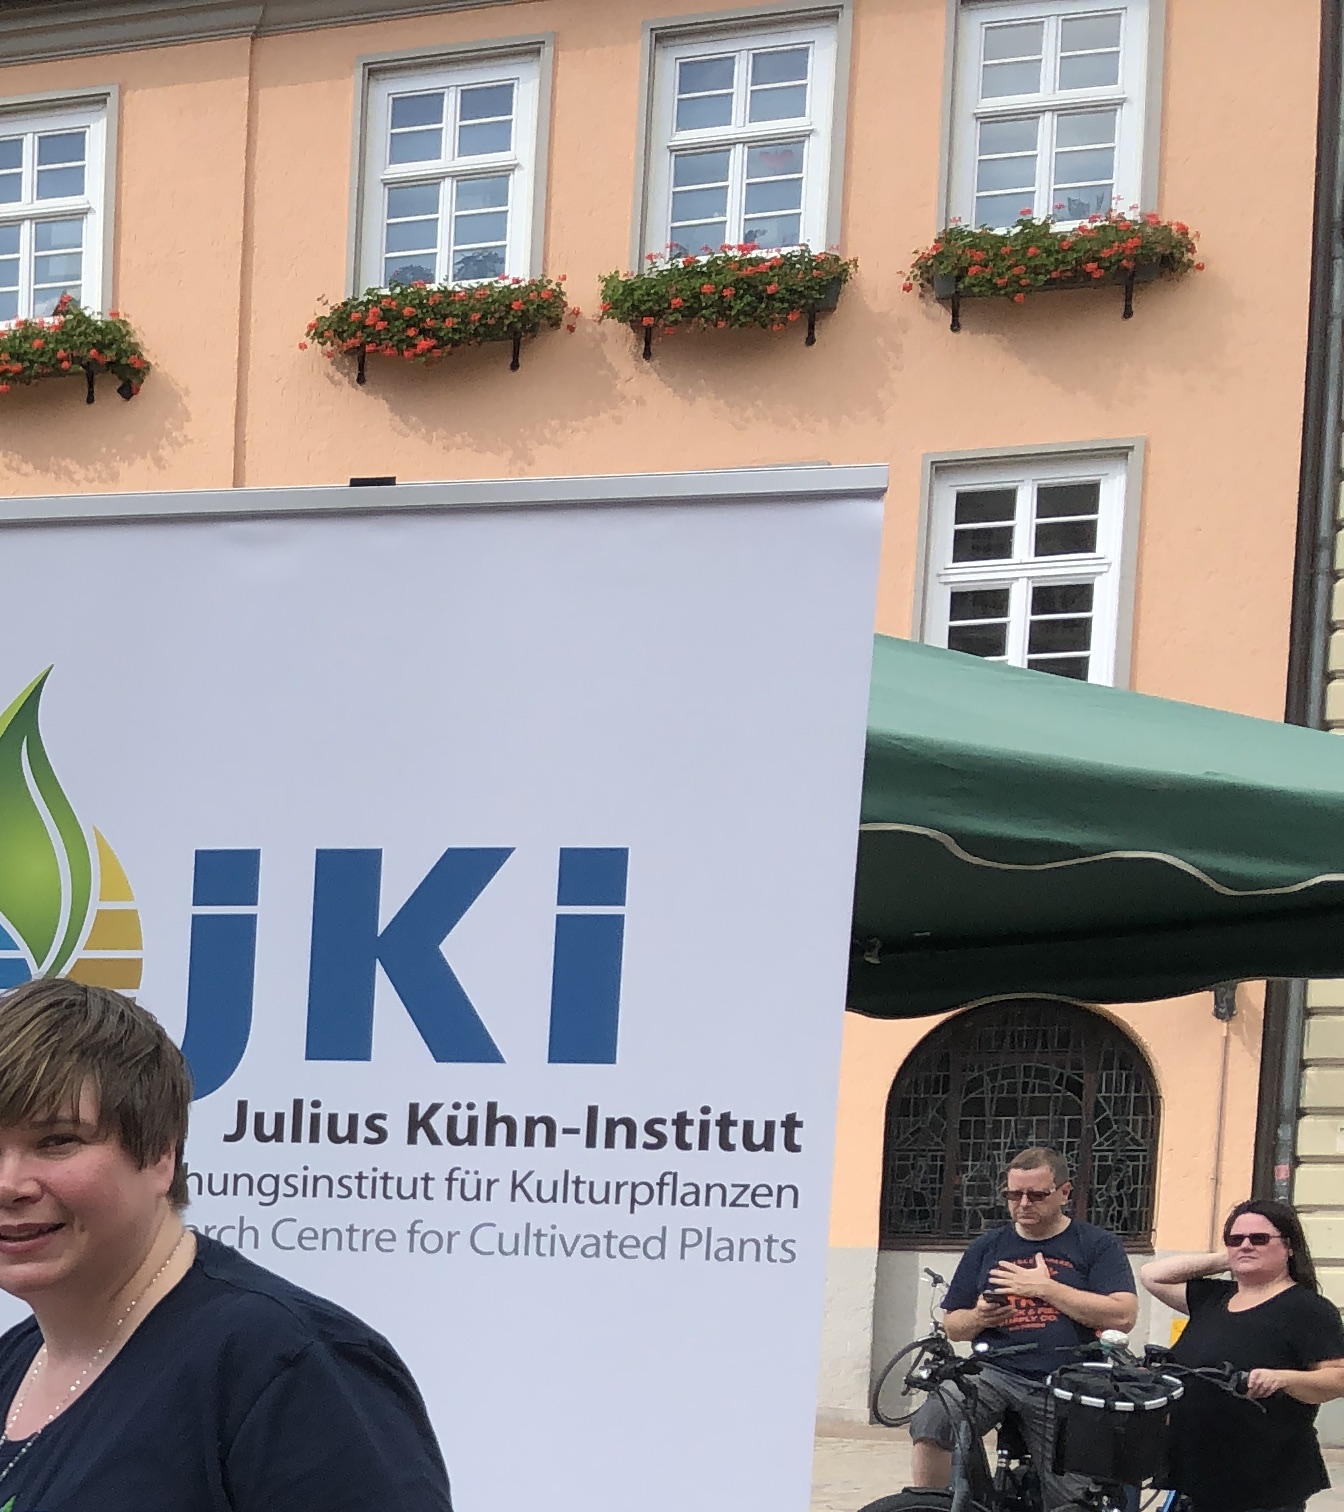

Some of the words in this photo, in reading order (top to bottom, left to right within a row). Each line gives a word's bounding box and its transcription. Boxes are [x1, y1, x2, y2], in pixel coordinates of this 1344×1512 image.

[223, 1098, 388, 1147] Julius
[407, 1101, 804, 1154] Kühn-Institut
[184, 1162, 434, 1206] hungsinstitut
[445, 1166, 500, 1202] für
[511, 1168, 800, 1213] Kulturpflanzen
[271, 1218, 398, 1254] Centre
[407, 1219, 461, 1254] for
[469, 1222, 668, 1262] Cultivated
[679, 1227, 797, 1265] Plants
